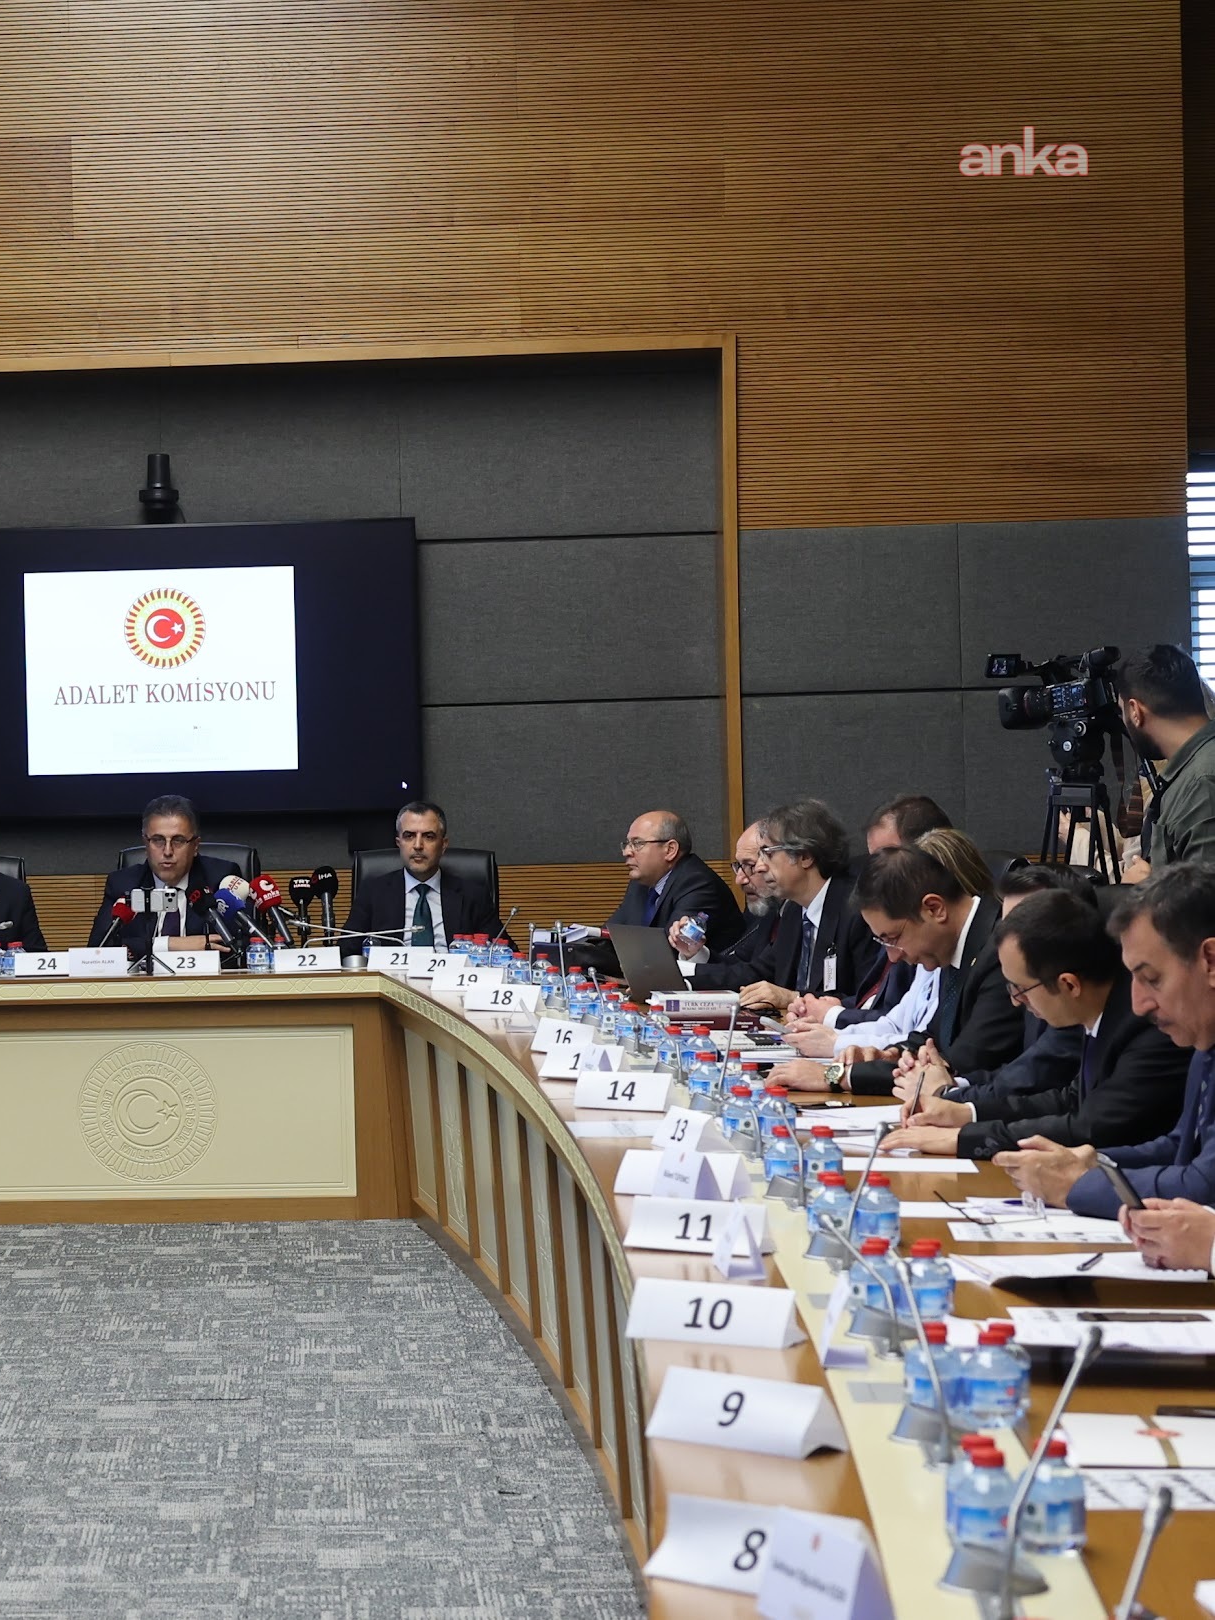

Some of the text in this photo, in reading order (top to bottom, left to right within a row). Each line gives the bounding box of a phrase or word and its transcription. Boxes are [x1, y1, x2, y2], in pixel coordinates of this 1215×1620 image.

[54, 677, 276, 706] ADALET KOMİSYONU
[37, 957, 58, 971] 24
[176, 956, 197, 970] 23
[297, 953, 318, 967] 22
[389, 952, 408, 966] 21
[456, 973, 478, 987] 19
[490, 989, 514, 1006] 18
[555, 1028, 573, 1044] 16
[606, 1080, 637, 1102] 14
[669, 1118, 689, 1142] 13
[675, 1212, 713, 1242] 11
[683, 1297, 734, 1331] 10
[717, 1390, 746, 1428] 9
[732, 1528, 768, 1572] 8
